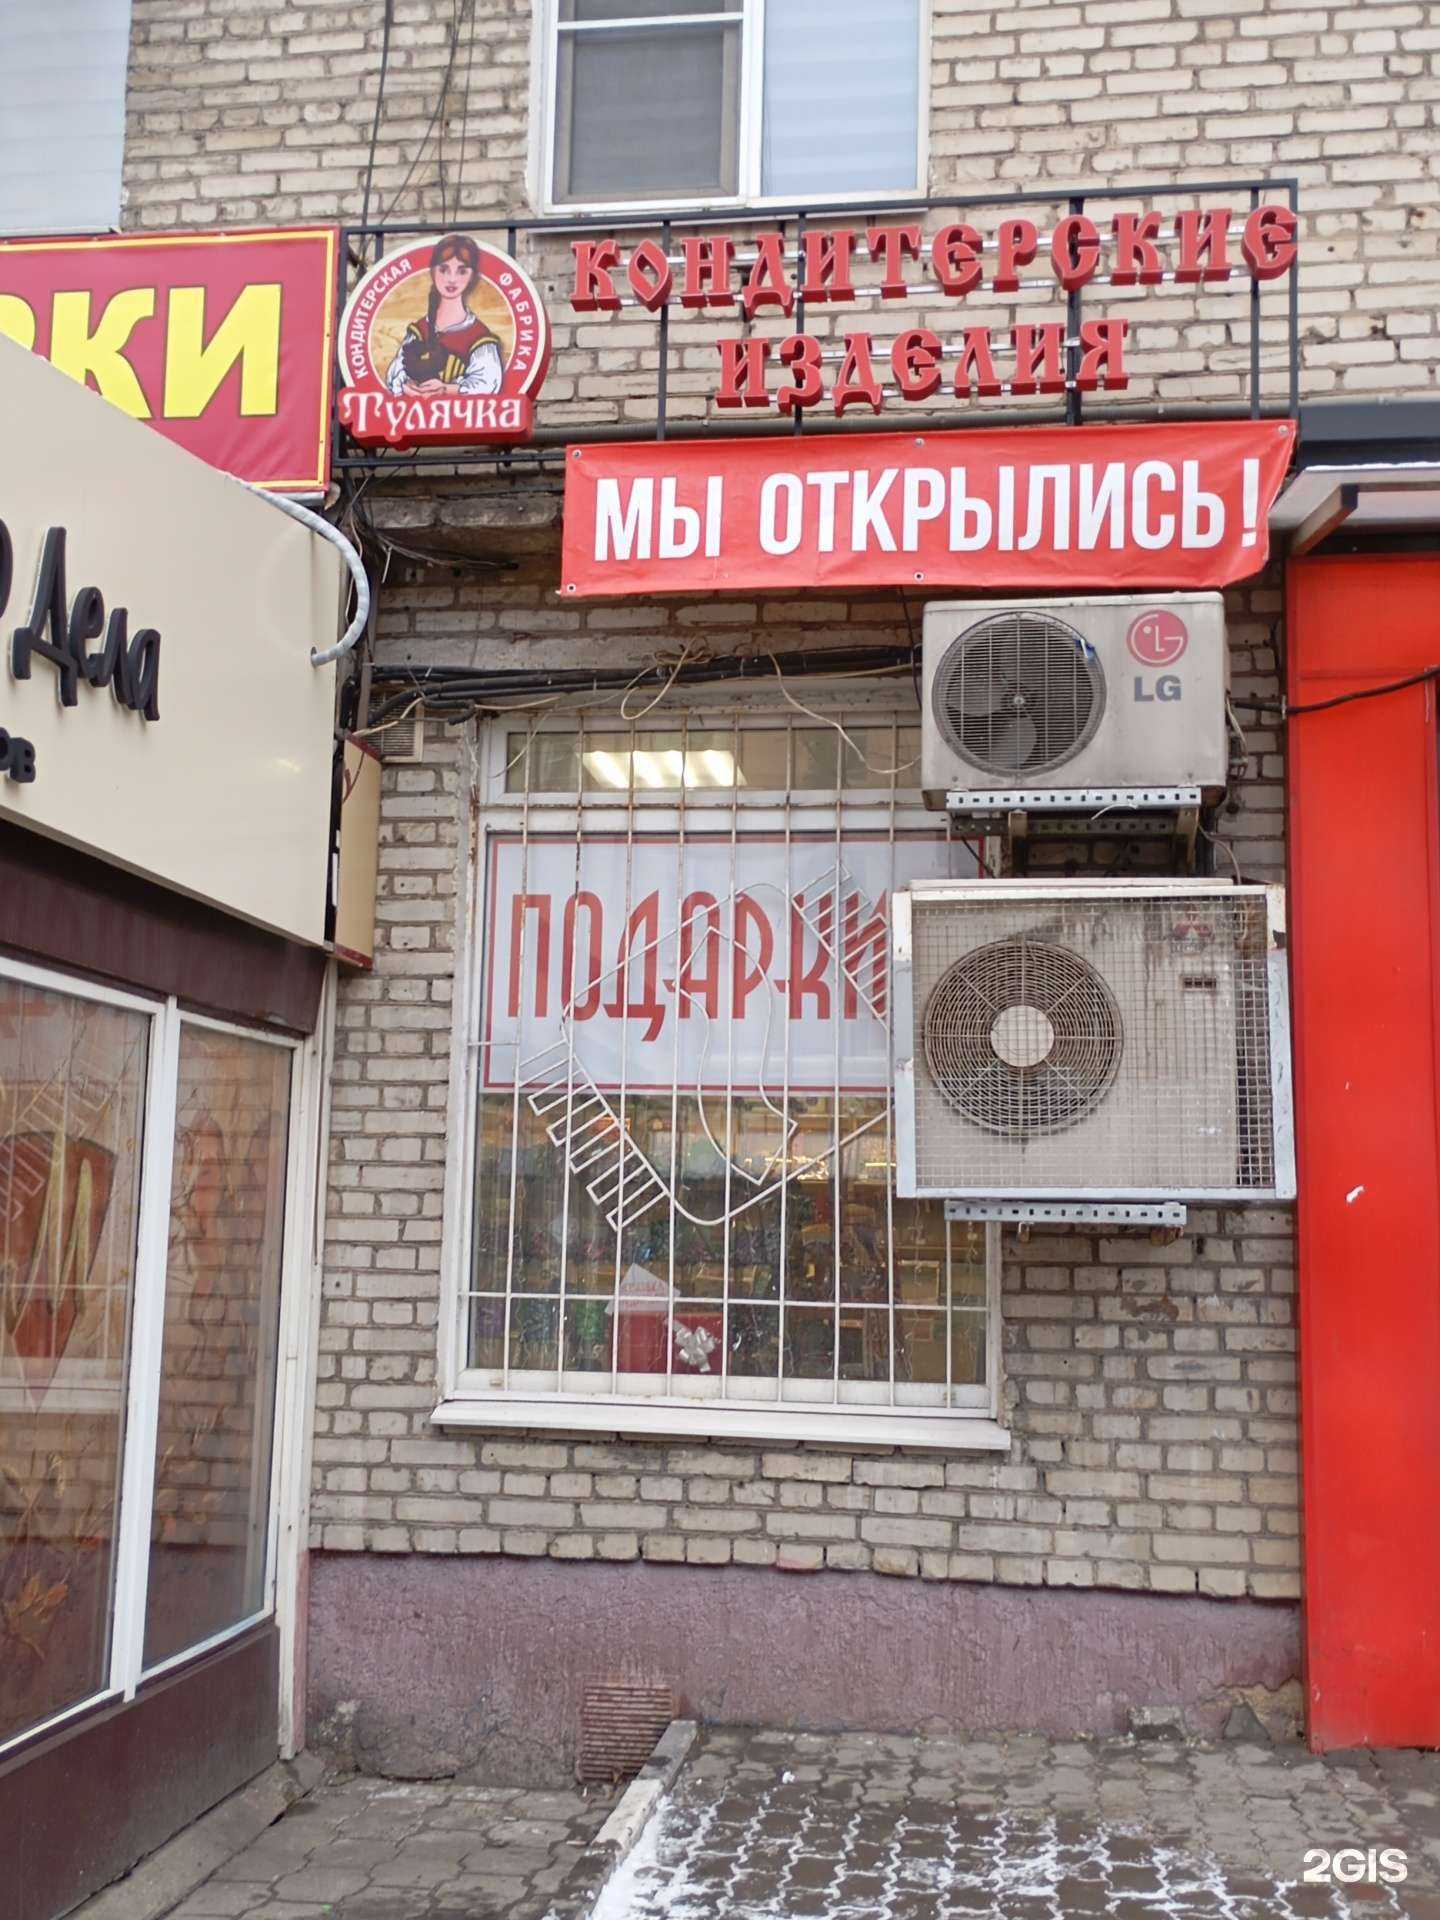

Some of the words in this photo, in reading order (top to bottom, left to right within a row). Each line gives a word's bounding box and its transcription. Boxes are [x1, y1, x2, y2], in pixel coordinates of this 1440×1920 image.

[569, 204, 1298, 320] КОНДИТЕРСКИЕ
[350, 258, 413, 379] КОНДИТЕРСКАЯ
[499, 271, 534, 372] ФАБРИКА
[716, 317, 1130, 417] ИЗДЕЛИЯ
[342, 391, 521, 436] Тулячка
[594, 475, 723, 562] МЫ
[758, 457, 1261, 556] ОТКРЫЛИСЬ!
[1133, 674, 1183, 703] LG
[507, 888, 890, 1042] ПОДАРКИ
